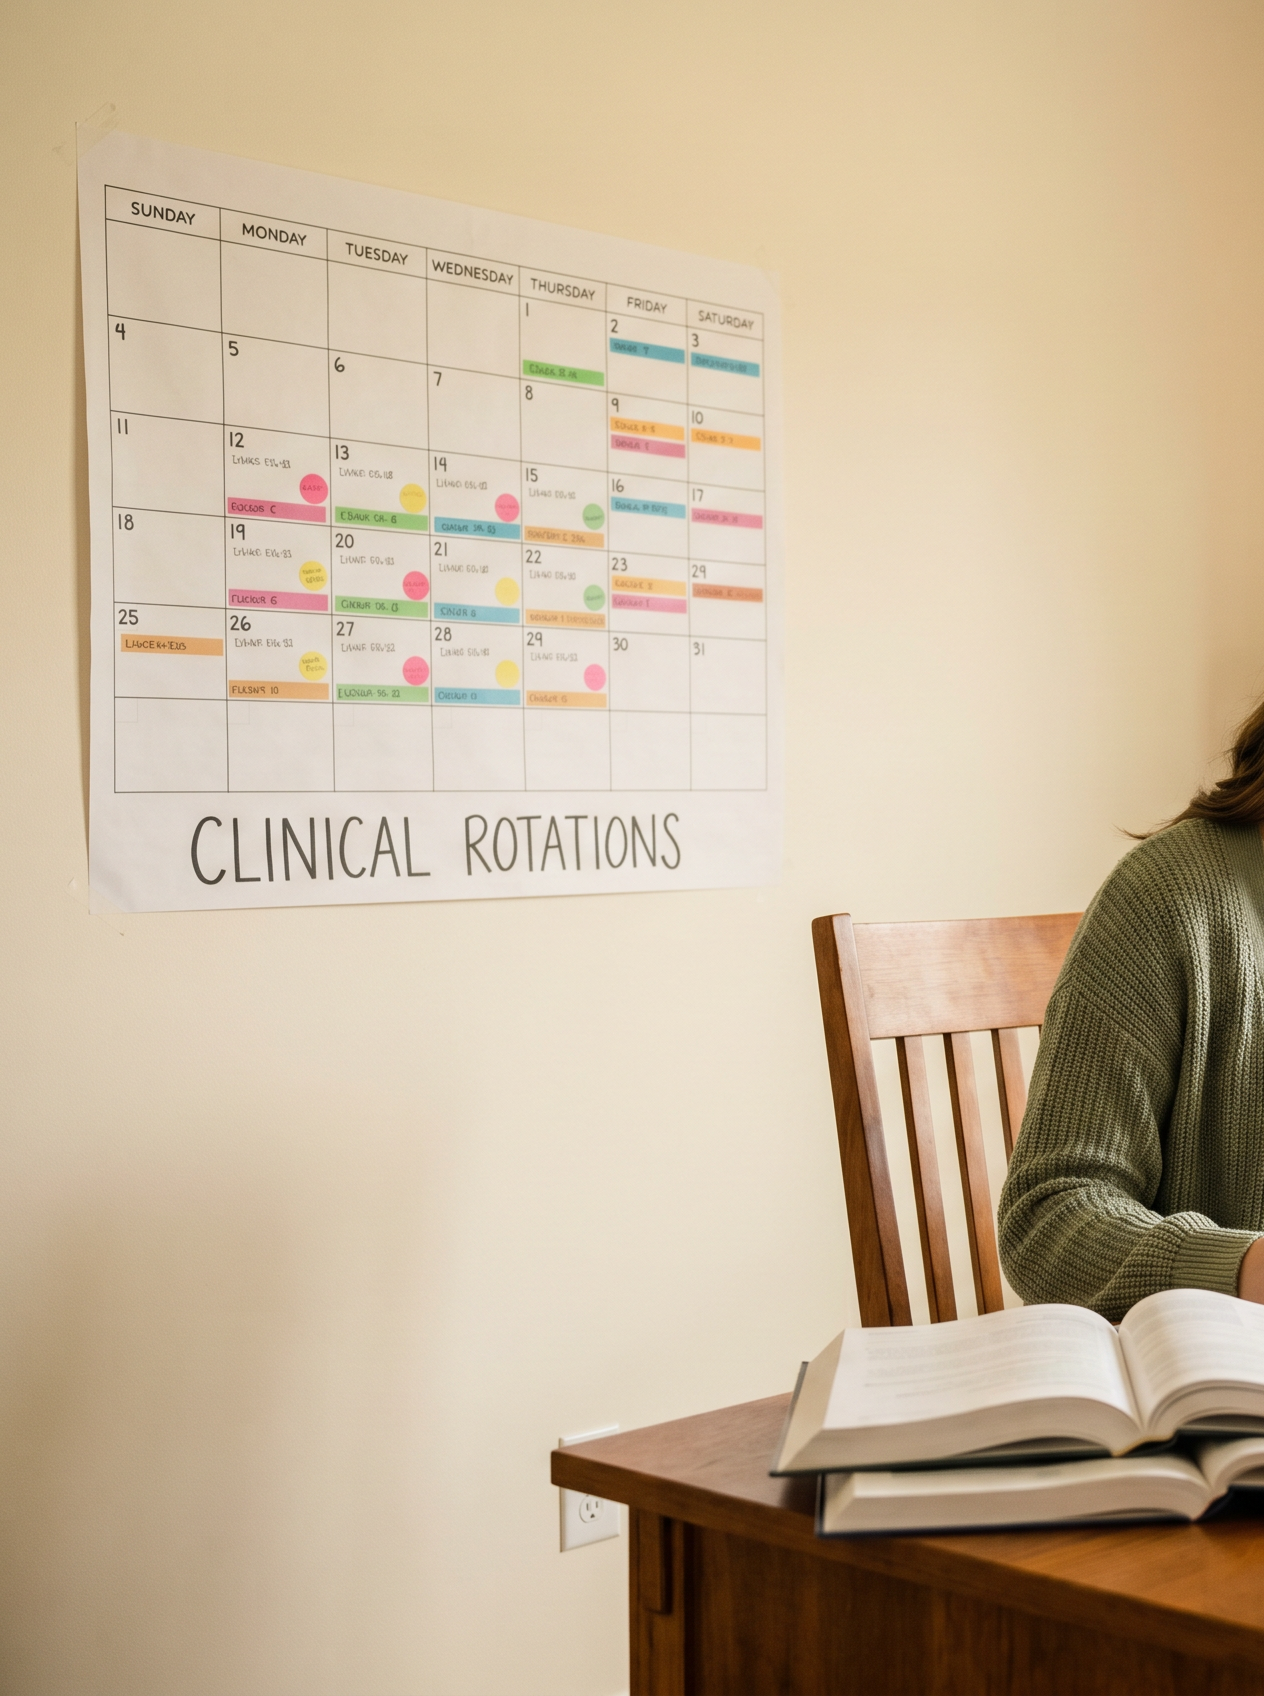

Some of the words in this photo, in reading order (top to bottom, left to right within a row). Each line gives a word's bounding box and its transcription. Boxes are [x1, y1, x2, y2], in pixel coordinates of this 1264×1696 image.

[131, 202, 196, 225] SUNDAY
[242, 223, 307, 247] MONDAY
[345, 242, 408, 266] TUESDAY
[431, 259, 514, 286] WEDNESDAY
[530, 277, 596, 301] THURSDAY
[626, 296, 668, 313] FRIDAY
[698, 309, 755, 330] SATURDAY
[610, 318, 619, 334] 2
[691, 332, 700, 348] 3
[114, 322, 126, 341] 4
[228, 340, 239, 357] 5
[334, 356, 346, 373] 6
[433, 370, 442, 387] 7
[525, 384, 534, 401] 8
[611, 397, 620, 413] 9
[691, 410, 704, 425] 10
[117, 417, 129, 435] 11
[229, 431, 245, 449] 12
[335, 444, 350, 461] 13
[434, 456, 448, 473] 14
[525, 467, 539, 483] 15
[611, 478, 625, 493] 16
[692, 488, 704, 502] 17
[118, 513, 135, 531] 18
[230, 523, 246, 541] 19
[335, 532, 355, 549] 20
[433, 541, 448, 557] 21
[525, 549, 542, 564] 22
[611, 556, 628, 572] 23
[118, 608, 139, 626] 25
[229, 614, 252, 632] 26
[336, 621, 355, 637] 27
[434, 626, 452, 642] 28
[526, 631, 543, 647] 29
[612, 636, 629, 652] 30
[692, 641, 705, 656] 31
[190, 815, 431, 886] CLINICAL
[464, 812, 681, 876] ROTATIONS
